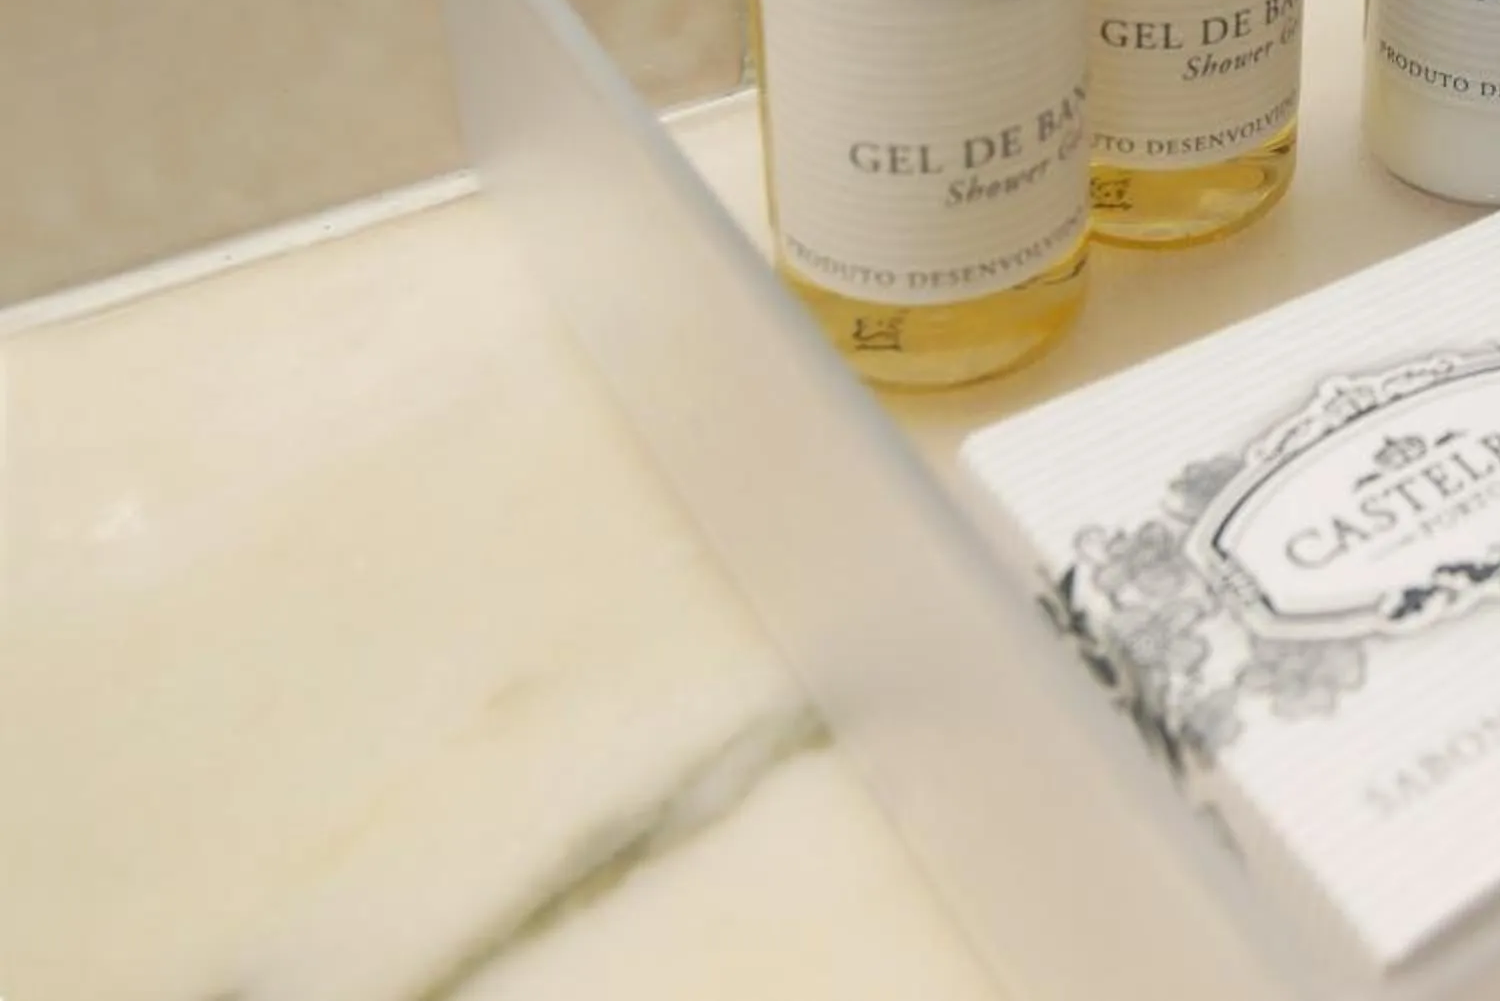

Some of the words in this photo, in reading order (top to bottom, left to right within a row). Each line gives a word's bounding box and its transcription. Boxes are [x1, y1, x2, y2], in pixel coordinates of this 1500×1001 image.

[1100, 18, 1184, 50] GEL
[1201, 9, 1252, 46] DE
[1181, 40, 1274, 82] Shower
[1379, 40, 1470, 93] PRODUTO
[848, 140, 944, 176] GEL
[962, 124, 1022, 170] DE
[944, 157, 1049, 209] Shower
